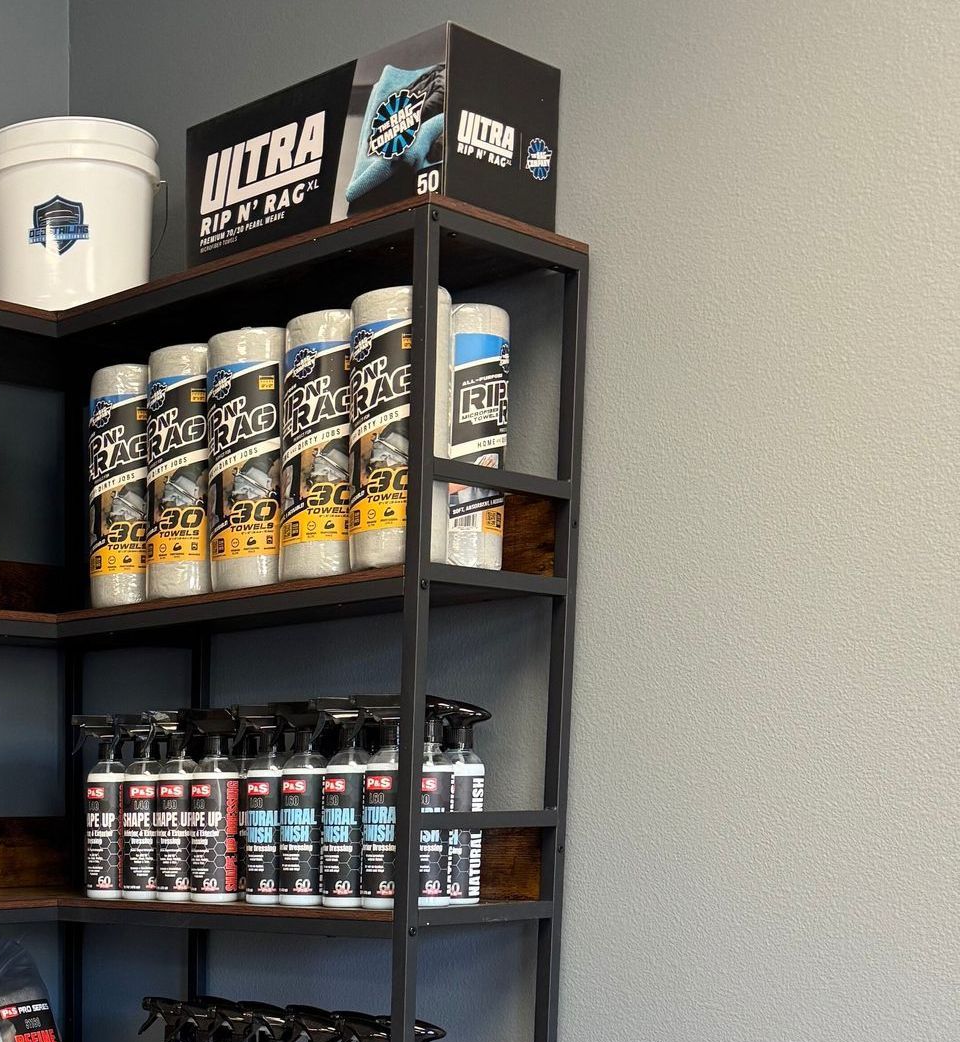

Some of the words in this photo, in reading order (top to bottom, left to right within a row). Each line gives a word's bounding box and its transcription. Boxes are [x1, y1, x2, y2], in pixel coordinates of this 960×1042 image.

[378, 121, 390, 132] THE
[390, 103, 413, 127] RAG
[371, 109, 421, 152] COMPANY
[457, 110, 515, 159] ULTRA
[200, 110, 325, 215] ULTRA
[457, 143, 474, 156] RIP
[488, 153, 506, 167] RAG
[417, 170, 439, 195] 50
[200, 209, 232, 237] RIP
[237, 200, 258, 224] N'
[264, 183, 305, 214] RAG
[306, 180, 319, 192] XL
[200, 231, 225, 247] PREMIUM
[226, 225, 244, 239] 70/30
[245, 219, 263, 231] PEARL
[265, 211, 285, 224] WEAVE
[213, 403, 276, 454] RAG
[358, 421, 378, 436] DIRTY
[380, 410, 399, 425] JOBS
[149, 415, 207, 464] RAG
[298, 435, 318, 449] DIRTY
[321, 429, 341, 440] JOBS
[477, 438, 495, 448] HOME
[151, 464, 169, 479] DIRTY
[170, 457, 188, 467] JOBS
[218, 455, 238, 470] DIRTY
[240, 448, 258, 459] JOBS
[97, 479, 115, 493] DIRTY
[118, 472, 136, 484] JOBS
[159, 507, 205, 530] 30
[230, 499, 279, 525] 30
[159, 530, 199, 538] TOWELS
[230, 523, 274, 532] TOWELS
[130, 786, 155, 798] P&S
[160, 786, 183, 797] P&S
[192, 784, 211, 797] P&S
[248, 784, 269, 794] P&S
[282, 780, 306, 793] P&S
[367, 777, 392, 790] P&S
[102, 812, 115, 827] UP
[123, 812, 150, 827] SHAPE
[208, 812, 222, 827] UP
[469, 830, 482, 896] NATURAL
[261, 879, 274, 889] 60
[295, 879, 311, 890] 60
[335, 880, 351, 891] 60
